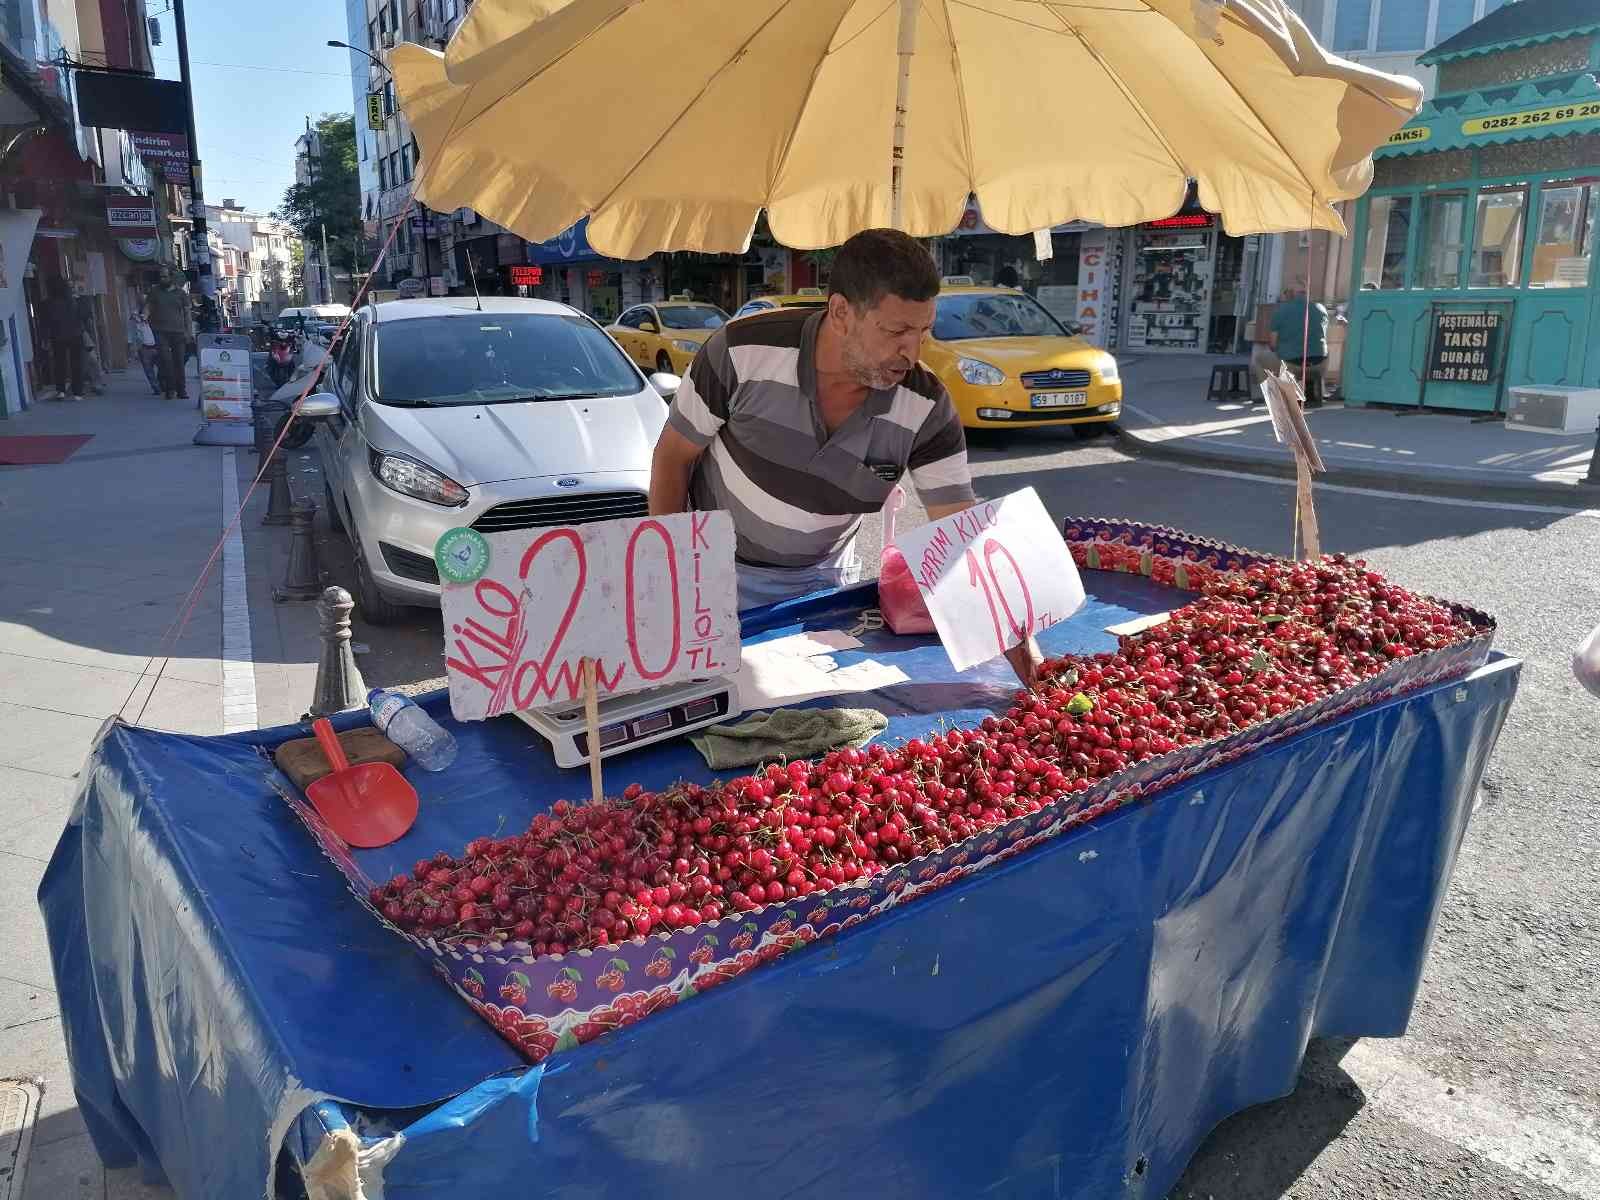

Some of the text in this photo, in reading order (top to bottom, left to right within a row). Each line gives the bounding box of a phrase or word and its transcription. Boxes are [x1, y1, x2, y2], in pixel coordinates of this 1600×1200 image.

[371, 96, 379, 122] SRC
[1482, 103, 1600, 130] 0282 262 69 20
[1444, 330, 1488, 348] TAKSİ
[1440, 350, 1485, 364] DURAĞI
[918, 526, 954, 596] YARIM
[967, 537, 1035, 653] 10
